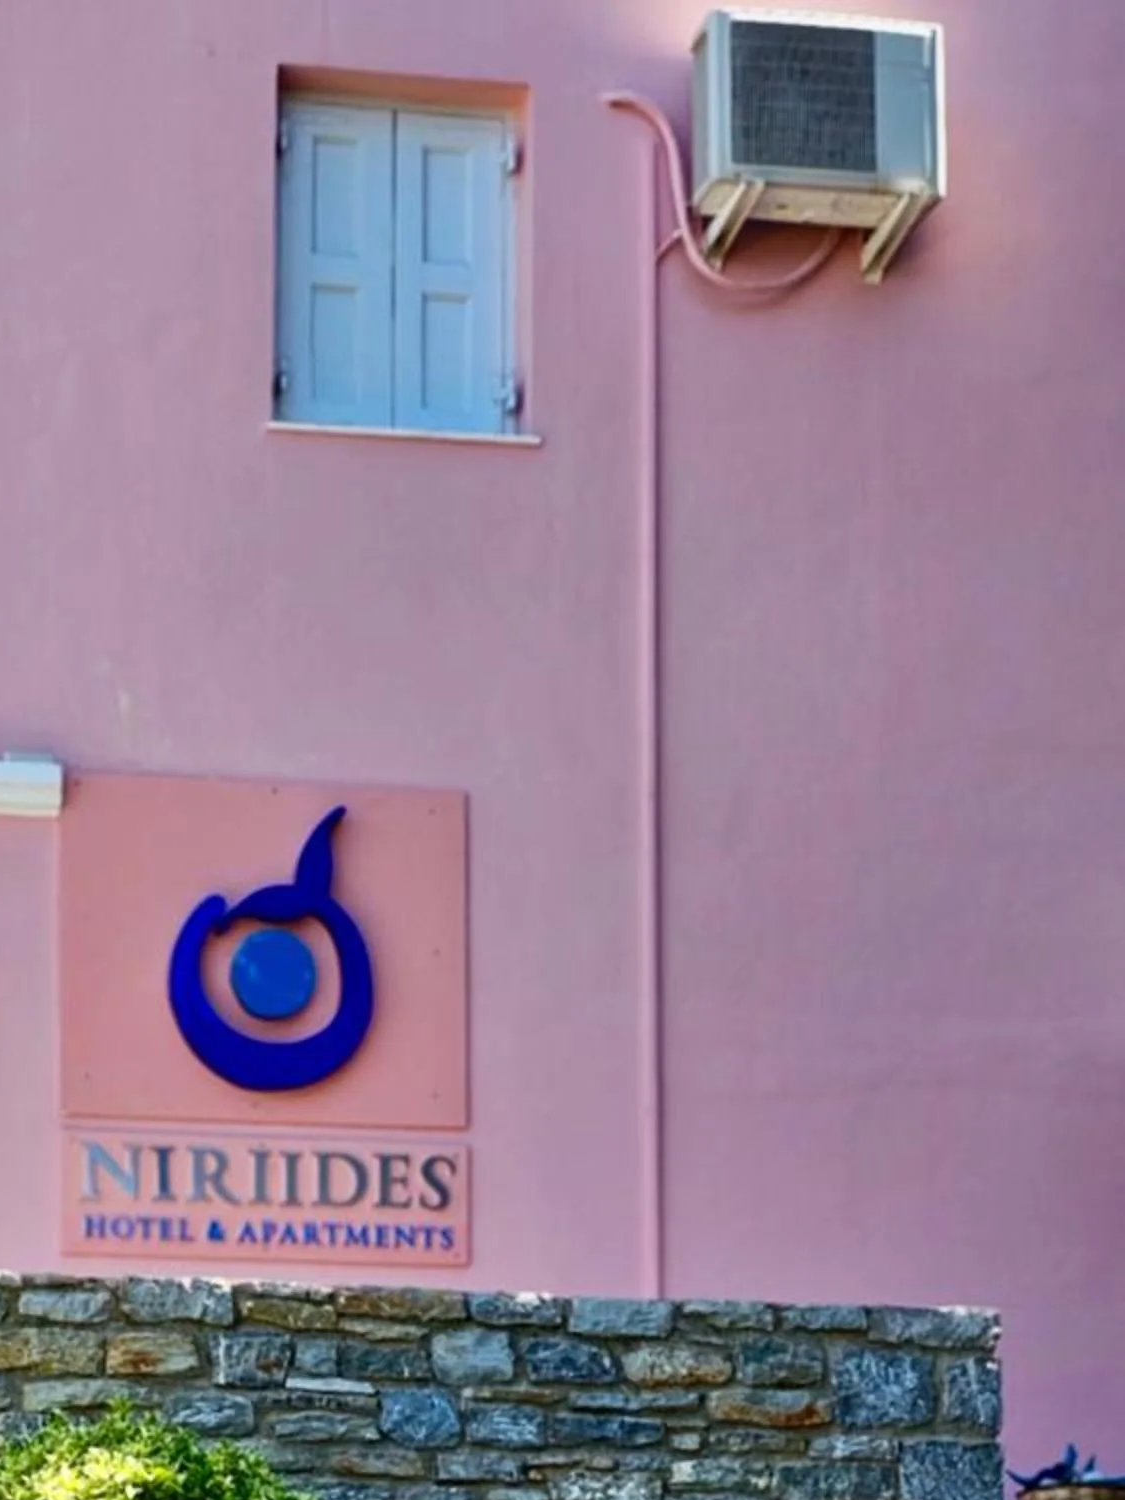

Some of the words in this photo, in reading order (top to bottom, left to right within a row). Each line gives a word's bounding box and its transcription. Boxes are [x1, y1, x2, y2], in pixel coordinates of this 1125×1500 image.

[81, 1140, 458, 1211] NIRIIDES
[84, 1215, 196, 1242] HOTEL
[207, 1219, 227, 1242] &
[238, 1220, 456, 1251] APARTMENTS
